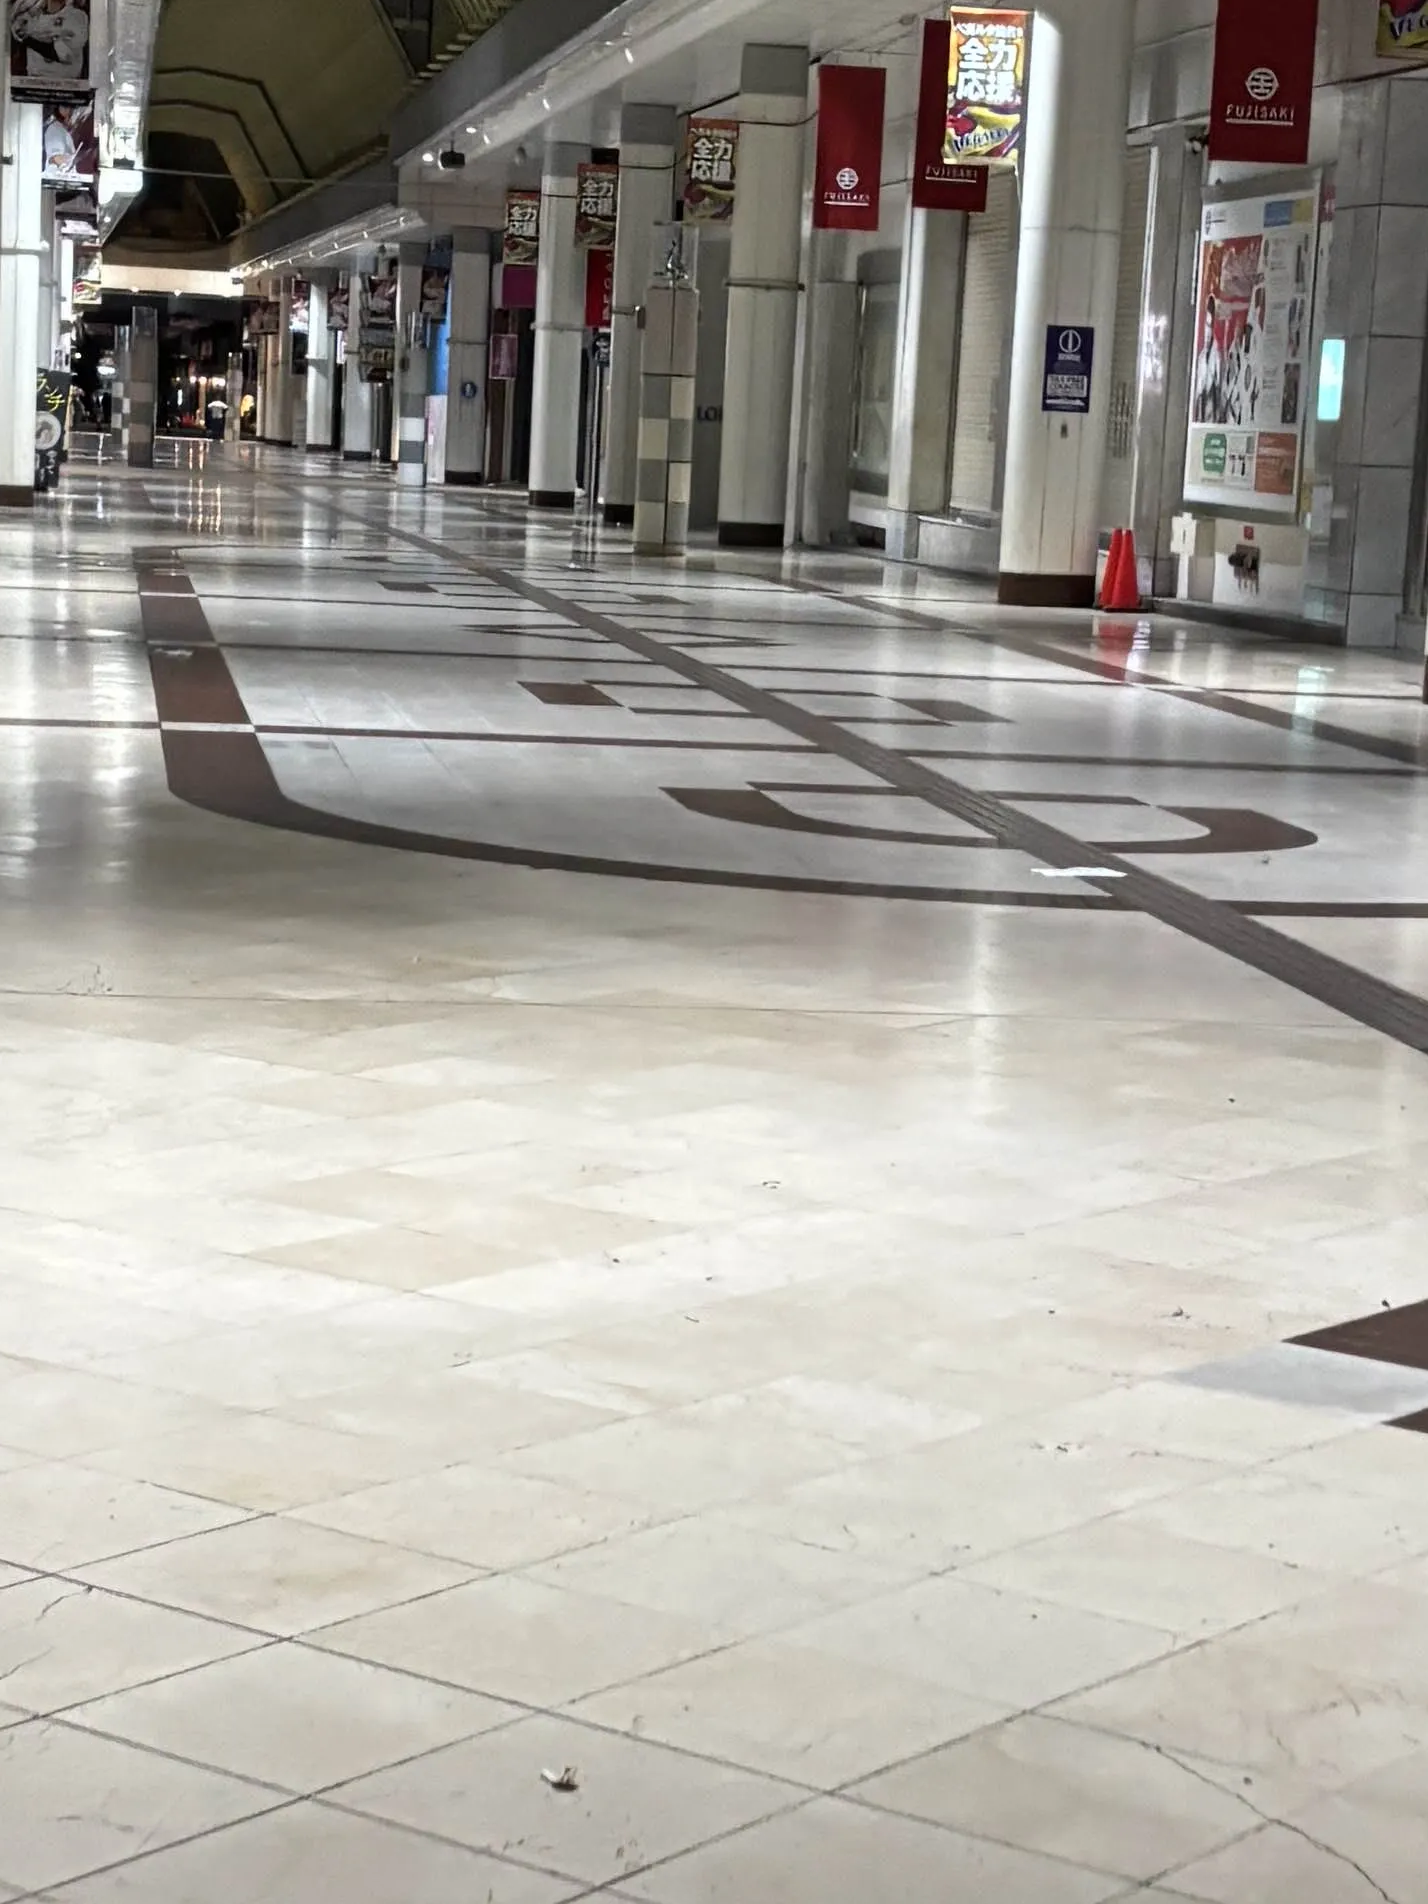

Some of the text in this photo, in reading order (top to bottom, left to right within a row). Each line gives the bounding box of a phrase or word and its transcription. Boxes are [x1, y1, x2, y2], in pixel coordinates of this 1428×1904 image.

[958, 36, 1018, 71] 全力
[1225, 102, 1295, 121] FUJISAKI
[693, 137, 733, 160] 全力
[582, 179, 614, 197] 全力
